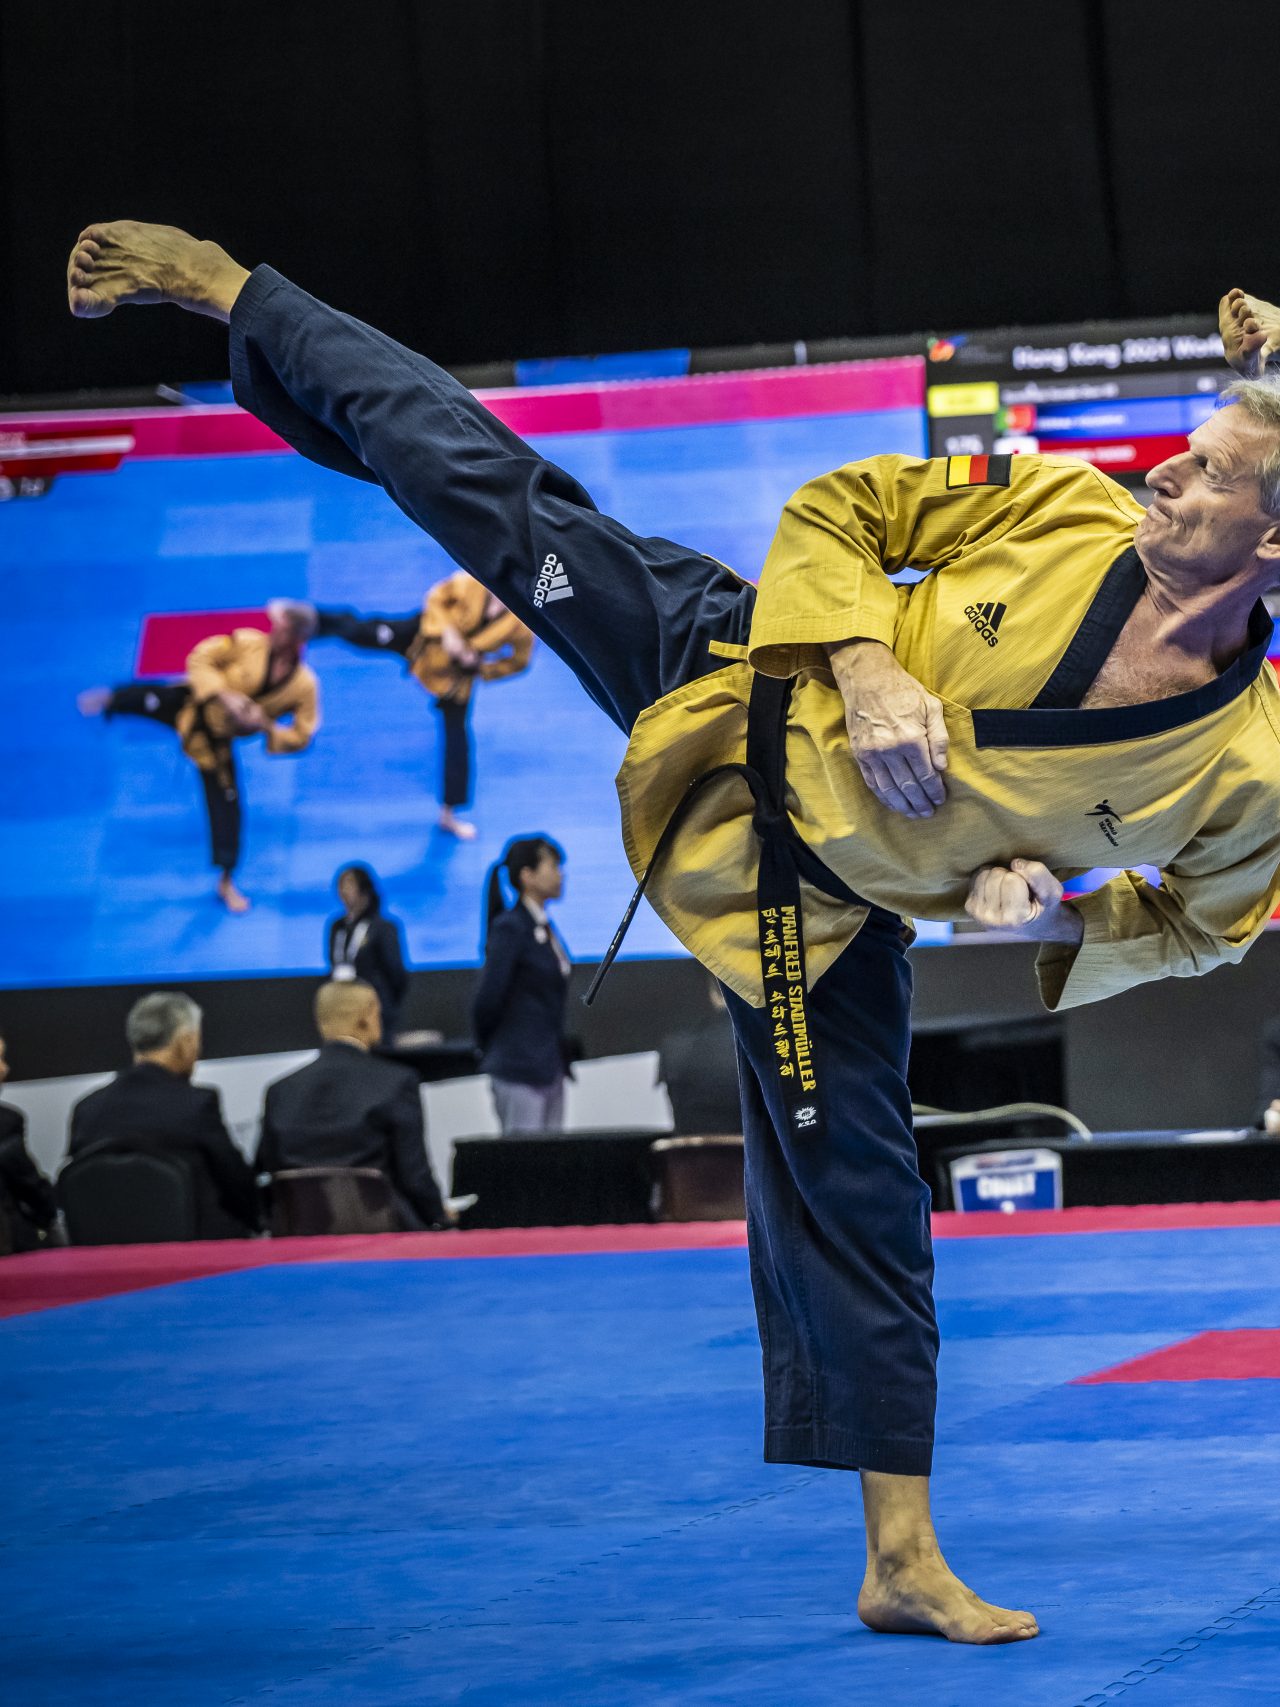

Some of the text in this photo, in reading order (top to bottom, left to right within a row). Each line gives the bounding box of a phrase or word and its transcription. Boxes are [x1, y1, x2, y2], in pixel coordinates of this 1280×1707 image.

[533, 553, 558, 609] adidas
[964, 605, 999, 647] adidas
[780, 905, 817, 1092] MANFRED STADTMÜLLER
